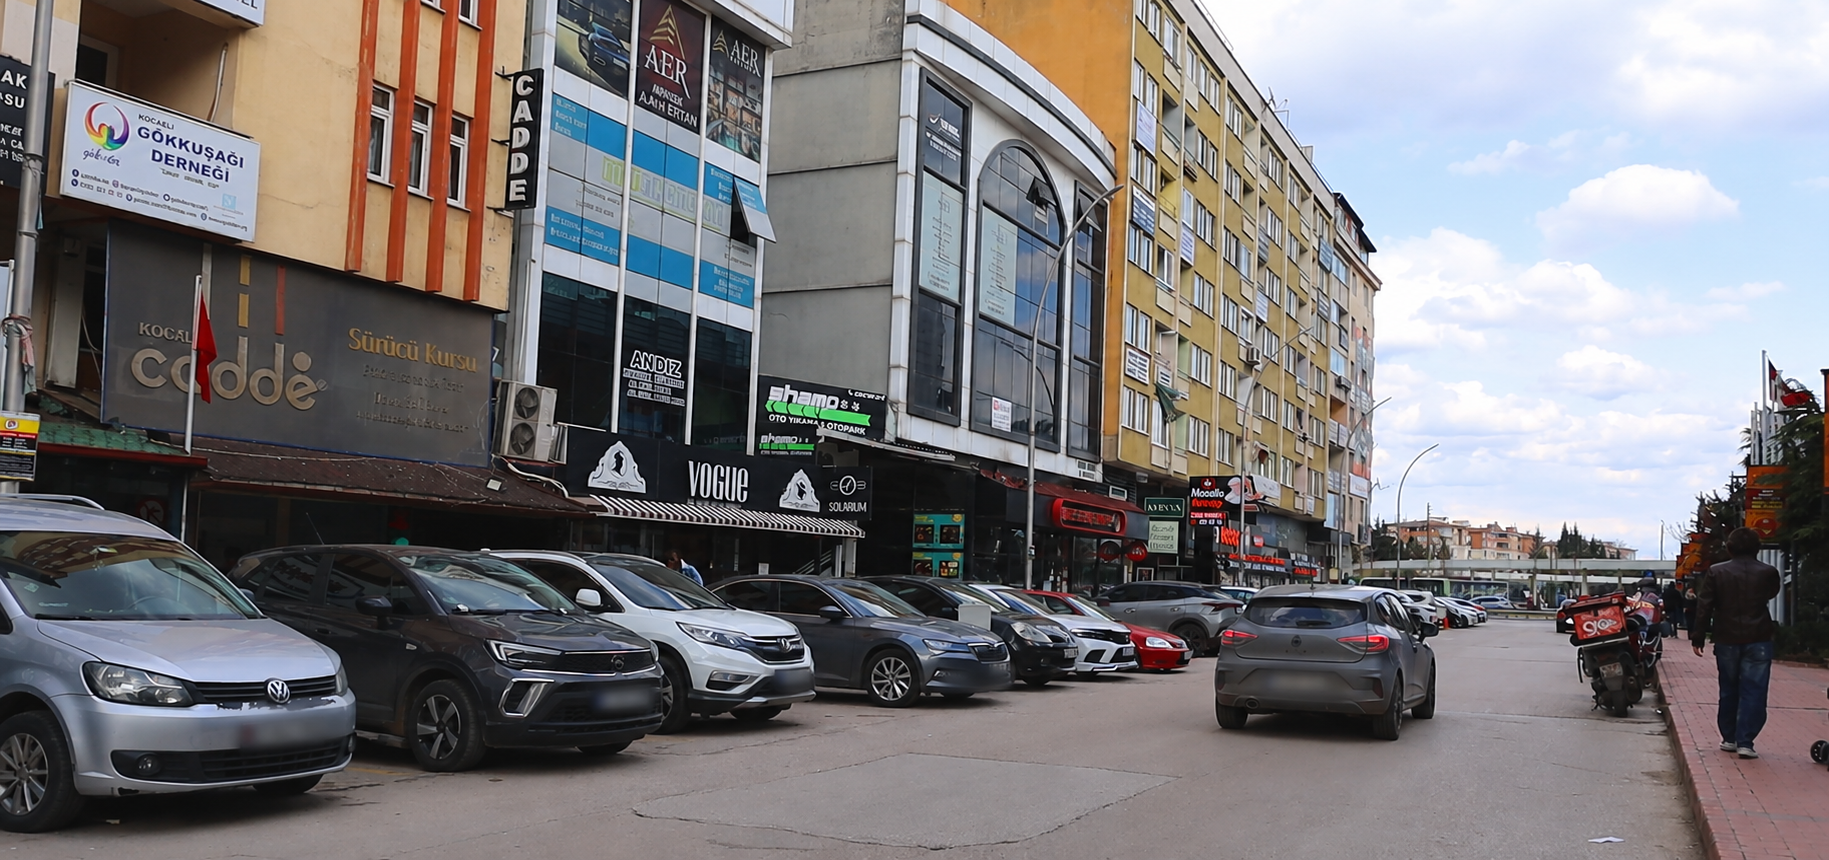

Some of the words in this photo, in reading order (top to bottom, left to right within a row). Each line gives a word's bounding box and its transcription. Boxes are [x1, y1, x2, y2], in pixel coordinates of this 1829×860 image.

[644, 45, 691, 99] AER
[731, 40, 761, 77] AER
[667, 103, 698, 128] ERTAN
[137, 126, 244, 169] GÖKKUŞAĞI
[508, 74, 536, 202] CADDE
[151, 149, 230, 183] DERNEĞİ
[348, 327, 419, 362] Sürücü
[424, 342, 478, 373] Kursu
[768, 413, 787, 423] OTO
[826, 422, 867, 435] OTOPARK
[828, 501, 867, 513] SOLARIUM
